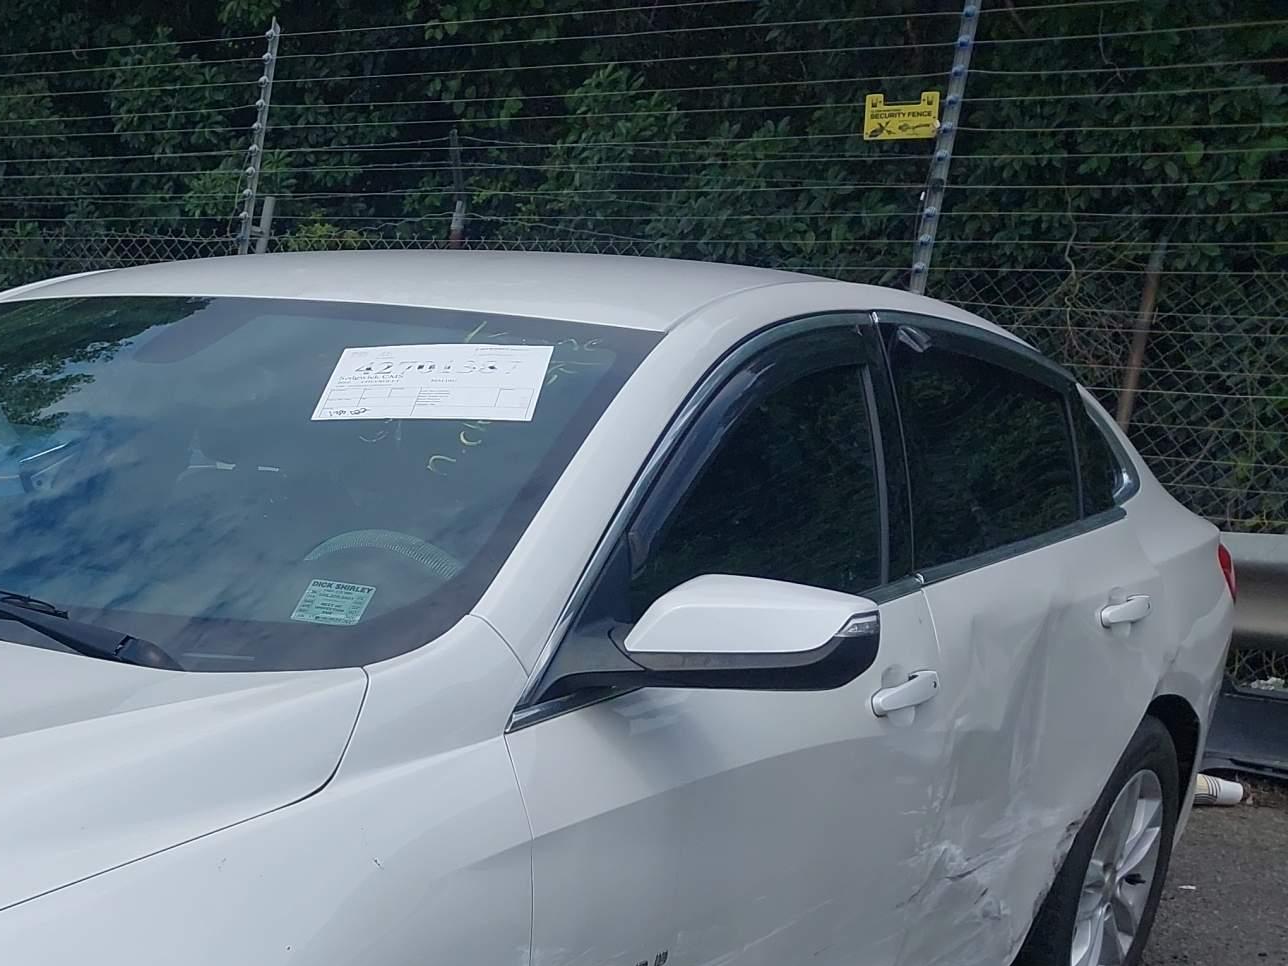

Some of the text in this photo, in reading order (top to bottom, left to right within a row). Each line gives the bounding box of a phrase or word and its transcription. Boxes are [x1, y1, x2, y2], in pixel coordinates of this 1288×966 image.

[870, 111, 907, 120] SECURITY
[907, 110, 933, 118] FENCE
[312, 580, 334, 588] DICK
[335, 583, 374, 594] SHIRLEY
